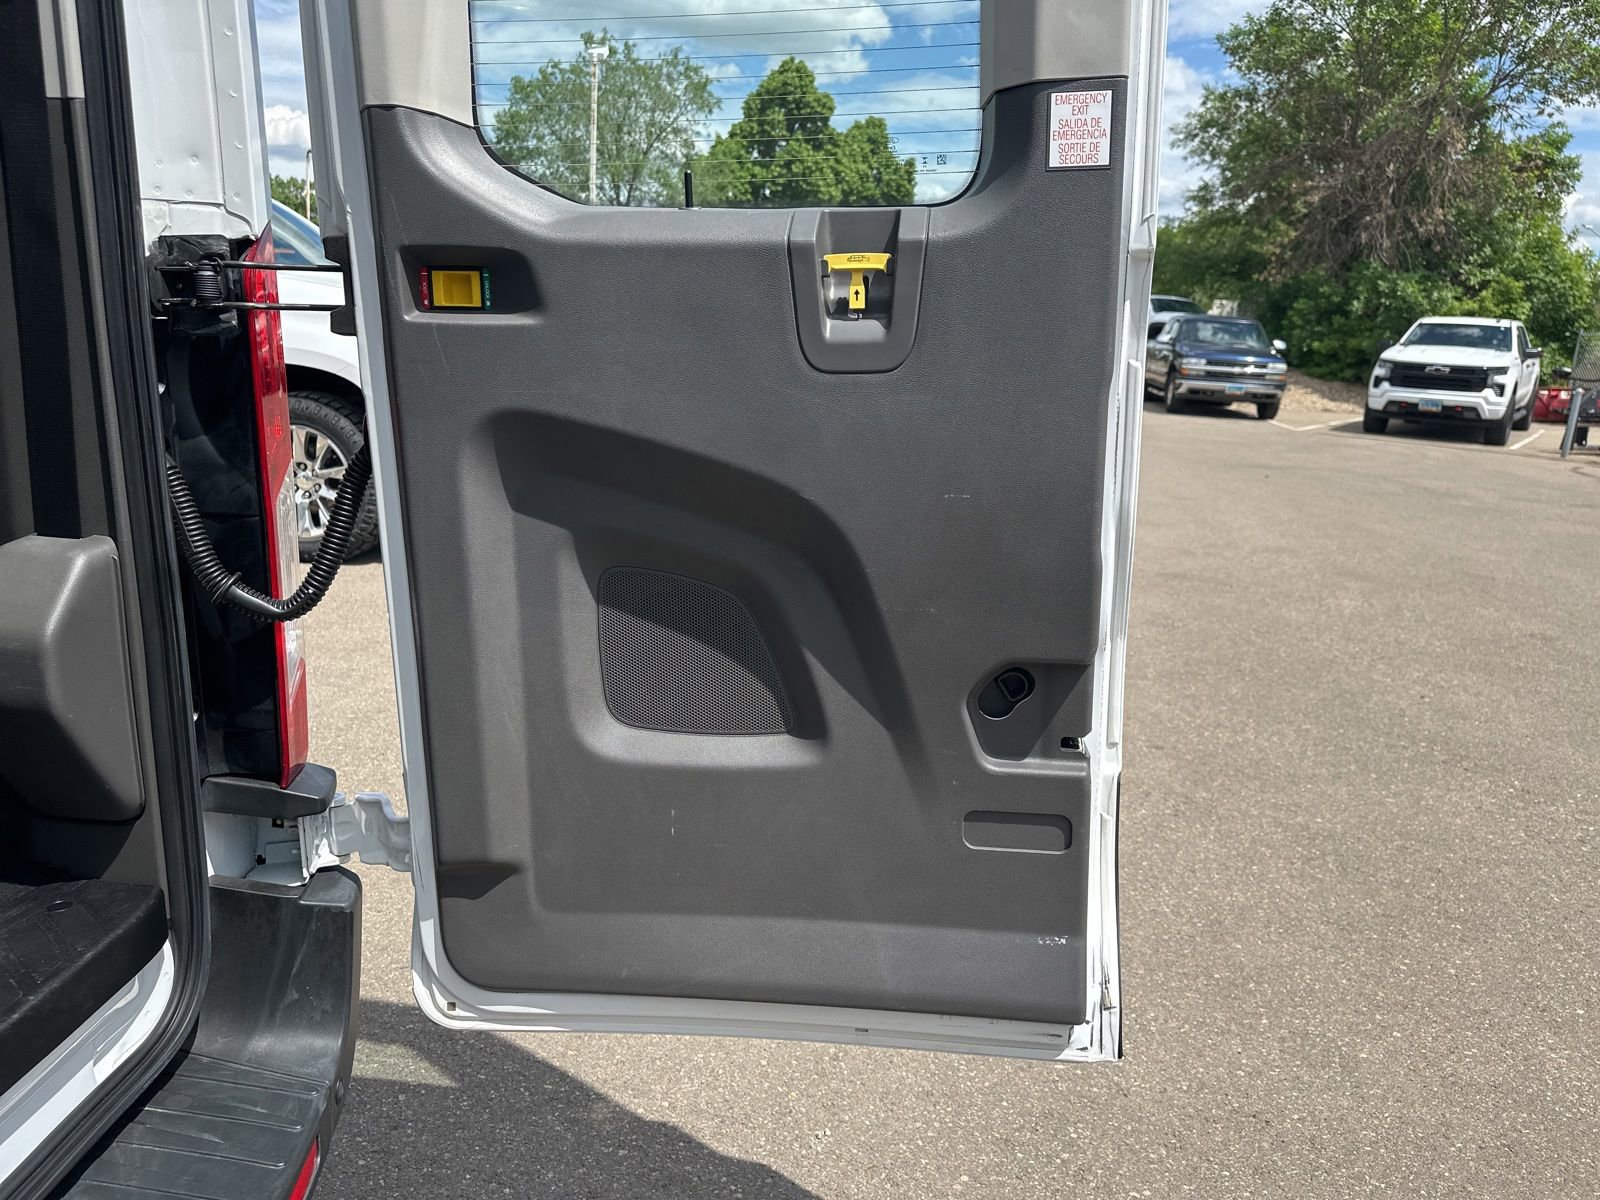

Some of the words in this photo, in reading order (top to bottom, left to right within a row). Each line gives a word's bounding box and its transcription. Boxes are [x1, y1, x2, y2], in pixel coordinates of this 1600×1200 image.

[1055, 92, 1107, 105] EMERGENCY
[1071, 105, 1090, 116] EXIT
[1058, 118, 1088, 129] SALIDA
[1090, 117, 1102, 128] DE
[1052, 129, 1107, 141] EMERGENCIA
[1058, 142, 1087, 154] SORTIE
[1089, 142, 1101, 152] DE
[1058, 153, 1099, 164] SECOURS
